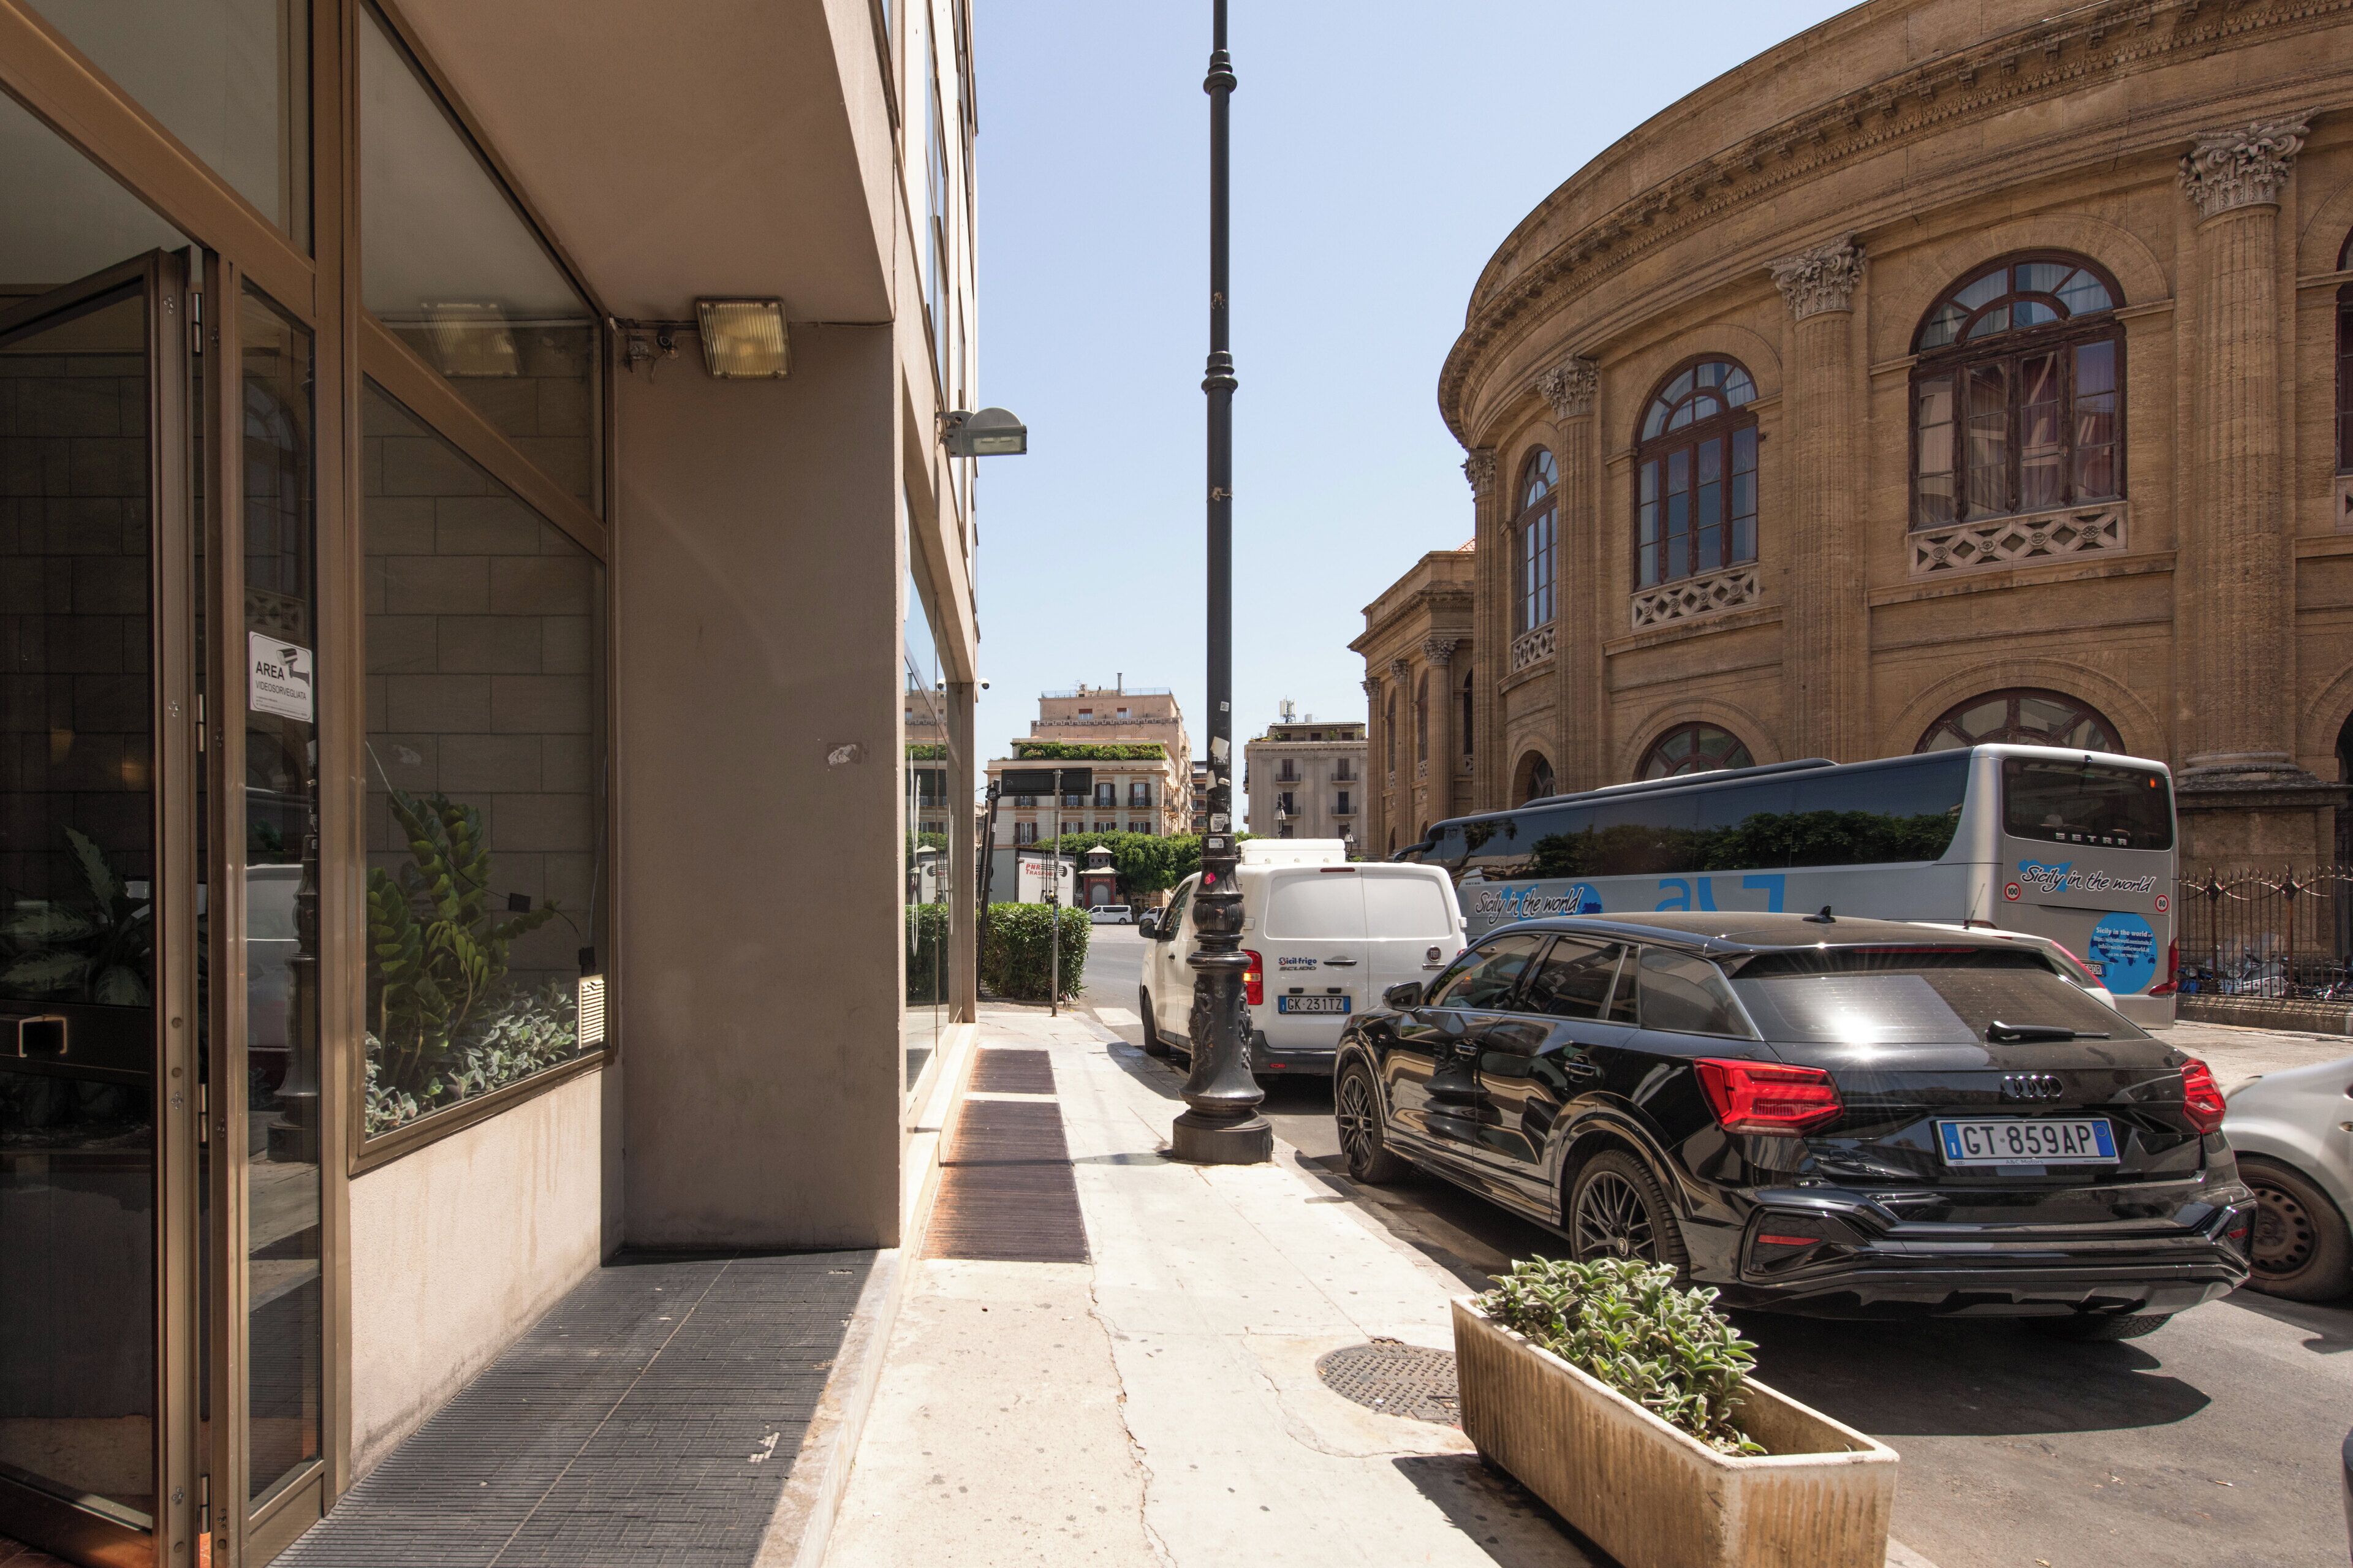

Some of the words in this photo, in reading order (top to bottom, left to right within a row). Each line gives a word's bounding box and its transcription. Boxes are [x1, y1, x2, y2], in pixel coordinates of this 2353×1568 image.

[256, 661, 285, 681] AREA
[256, 680, 307, 700] VIDEOSORVEGLIATA
[2055, 833, 2127, 846] SETRA
[2021, 865, 2065, 893] Sicily
[2066, 871, 2082, 888] in
[2085, 871, 2109, 891] the
[2112, 876, 2156, 893] world
[1476, 890, 1506, 926] Sicily
[1507, 892, 1518, 917] in
[1521, 888, 1541, 918] the
[1542, 887, 1583, 913] world
[2085, 964, 2101, 974] 9DR
[1287, 998, 1301, 1010] GK
[1306, 998, 1343, 1010] 231TZ
[1963, 1126, 1996, 1154] GT
[2006, 1125, 2090, 1154] 859AP
